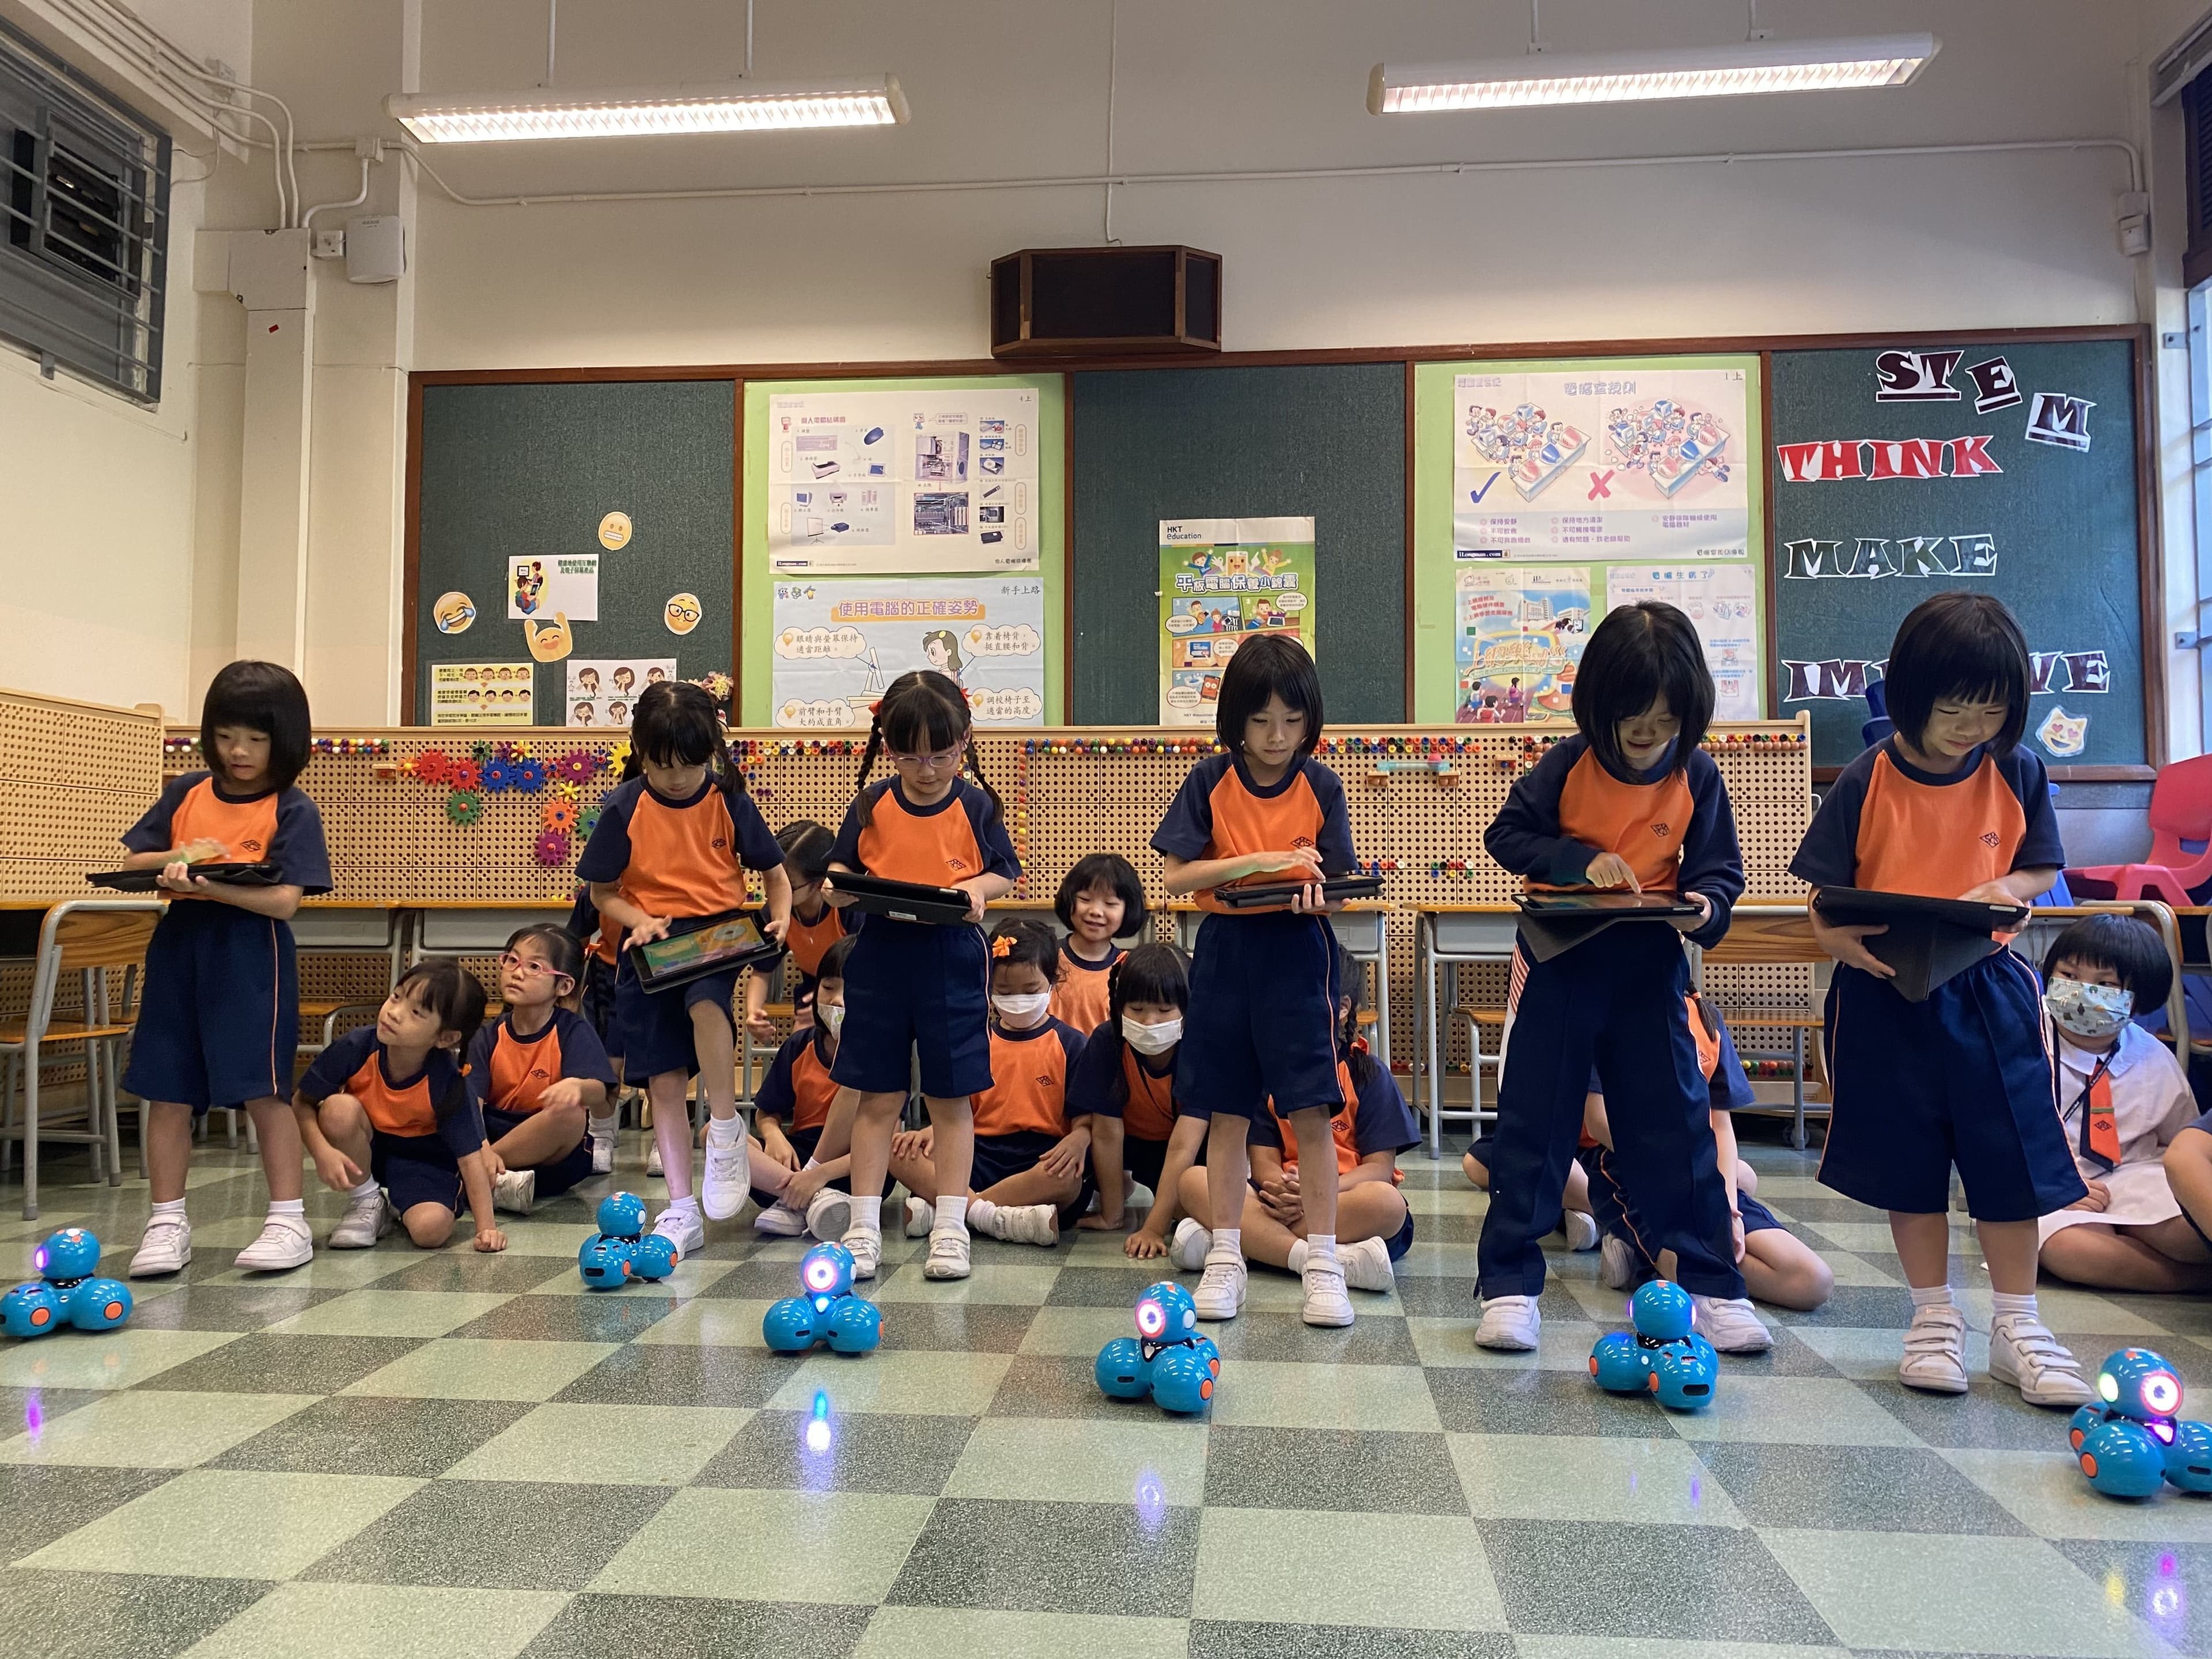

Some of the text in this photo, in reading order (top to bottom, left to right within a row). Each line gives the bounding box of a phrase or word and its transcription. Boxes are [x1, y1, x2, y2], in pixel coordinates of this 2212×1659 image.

[1876, 350, 2097, 452] STEM
[1777, 435, 2003, 482] THINK
[1166, 532, 1202, 540] education
[1784, 534, 1998, 579] MAKE
[1001, 585, 1040, 595] 新手上路
[1176, 574, 1298, 593] 平板電腦保養小錦囊
[838, 600, 979, 617] 使用電腦的正確姿勢
[1782, 650, 2111, 702] IMVE
[986, 695, 1031, 704] 調校椅子至
